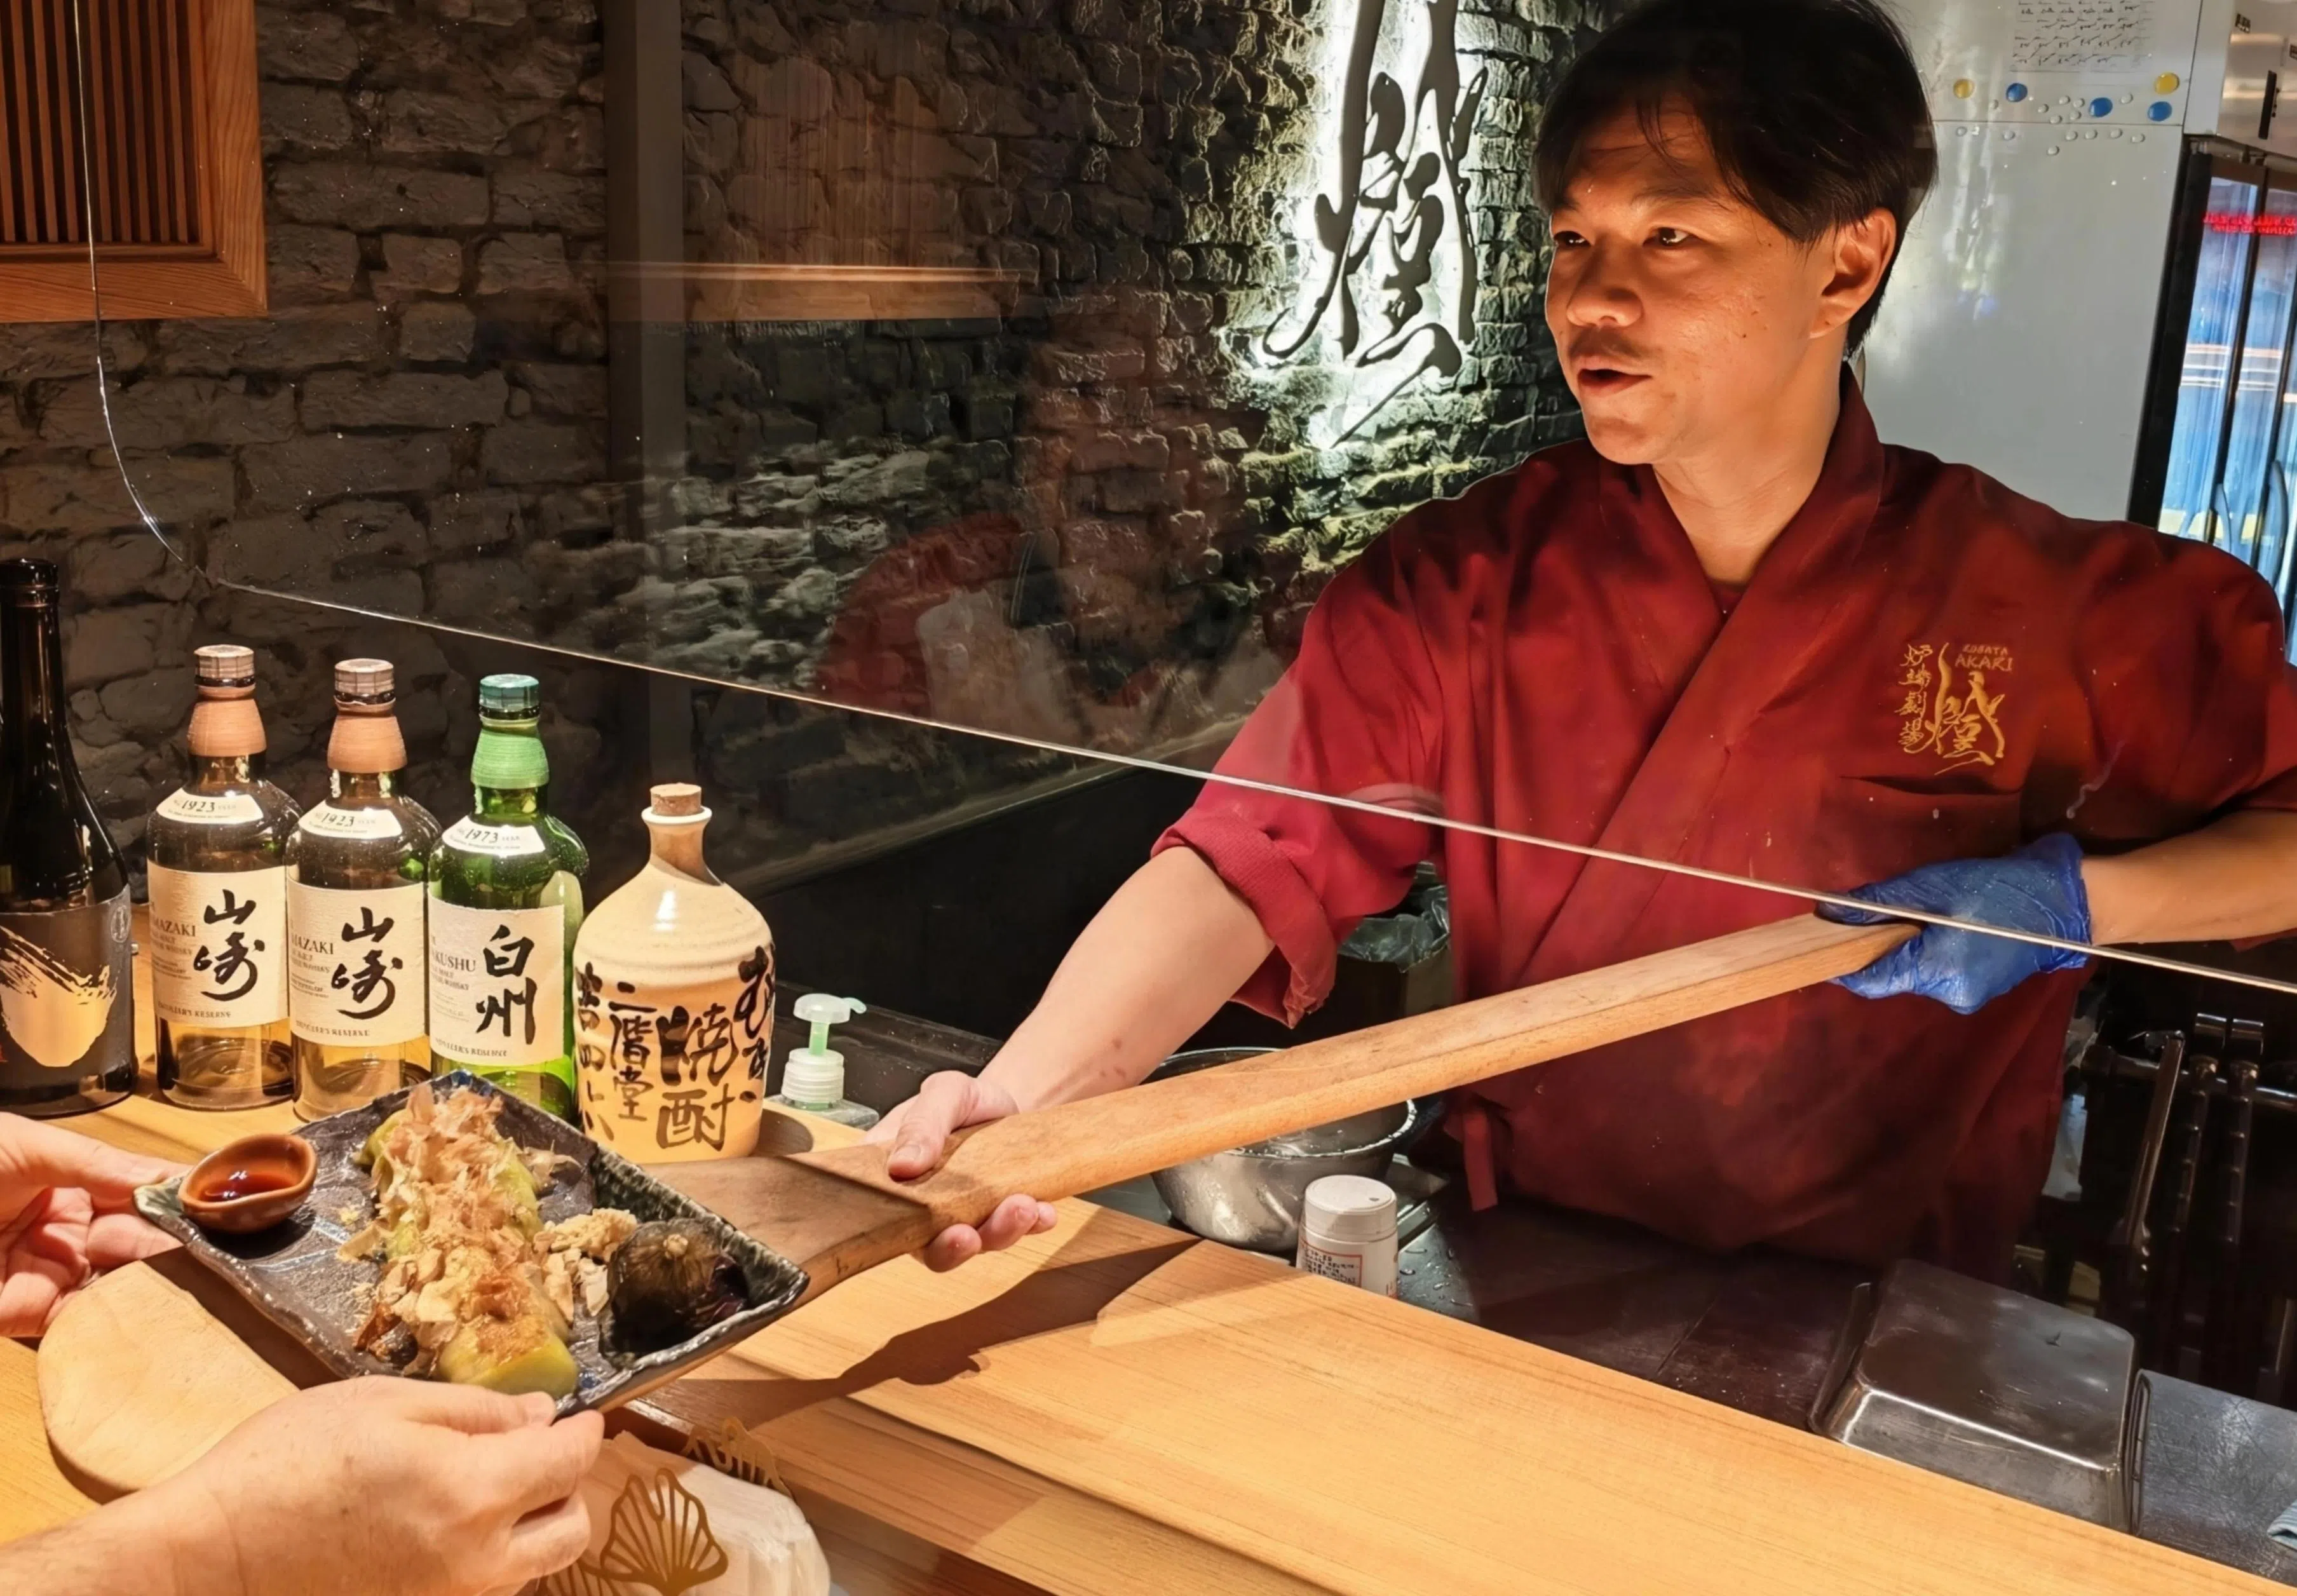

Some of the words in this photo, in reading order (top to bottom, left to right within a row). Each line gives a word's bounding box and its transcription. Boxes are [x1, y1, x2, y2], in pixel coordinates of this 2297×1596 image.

[1955, 653, 2013, 672] AKARI
[182, 800, 215, 813] 1923
[322, 813, 355, 827] 1923
[465, 828, 498, 843] 1973
[193, 889, 266, 1002] 山崎
[331, 906, 403, 1020] 山崎
[475, 924, 538, 1045] 白州
[609, 982, 657, 1121] 二階堂
[656, 1003, 739, 1151] 焼酎
